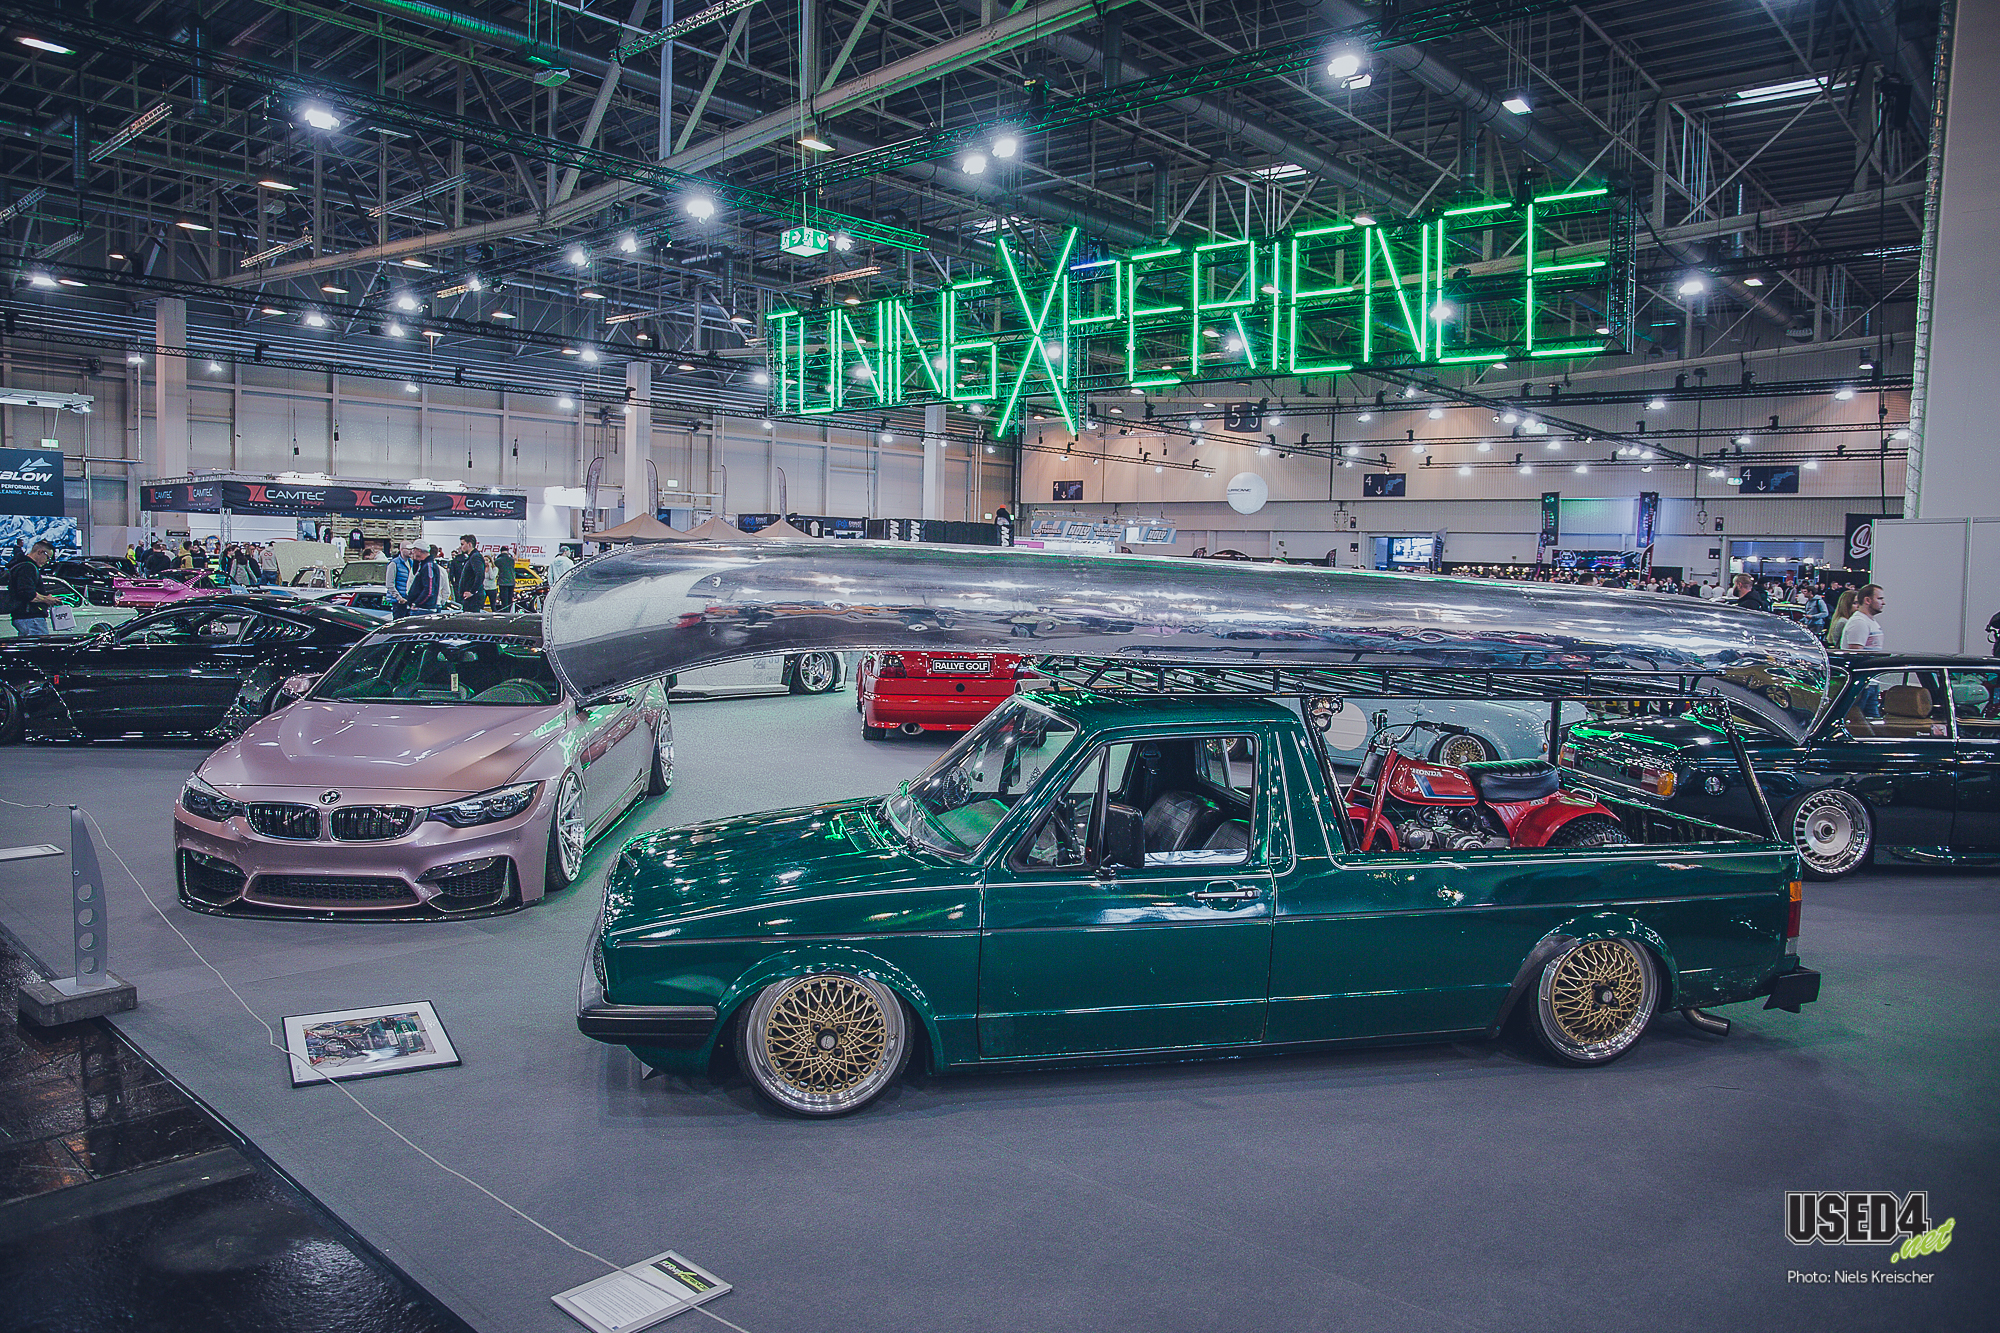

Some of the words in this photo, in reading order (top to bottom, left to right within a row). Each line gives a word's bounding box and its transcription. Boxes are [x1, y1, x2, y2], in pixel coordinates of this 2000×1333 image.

[0, 471, 53, 482] BLOW
[1742, 469, 1751, 480] 4
[1365, 475, 1372, 486] 4
[1054, 482, 1059, 491] 4
[155, 490, 173, 500] CAMTEC
[193, 487, 213, 498] CAMTEC
[266, 489, 325, 501] CAMTEC
[371, 495, 424, 505] CAMTEC
[466, 499, 514, 509] CAMTEC
[1067, 525, 1091, 536] HOLY
[1147, 530, 1167, 540] HOLY
[404, 633, 536, 647] MONEYBURNER
[934, 661, 965, 671] RALLYE
[965, 661, 988, 671] GOLF
[1410, 768, 1443, 777] HONDA
